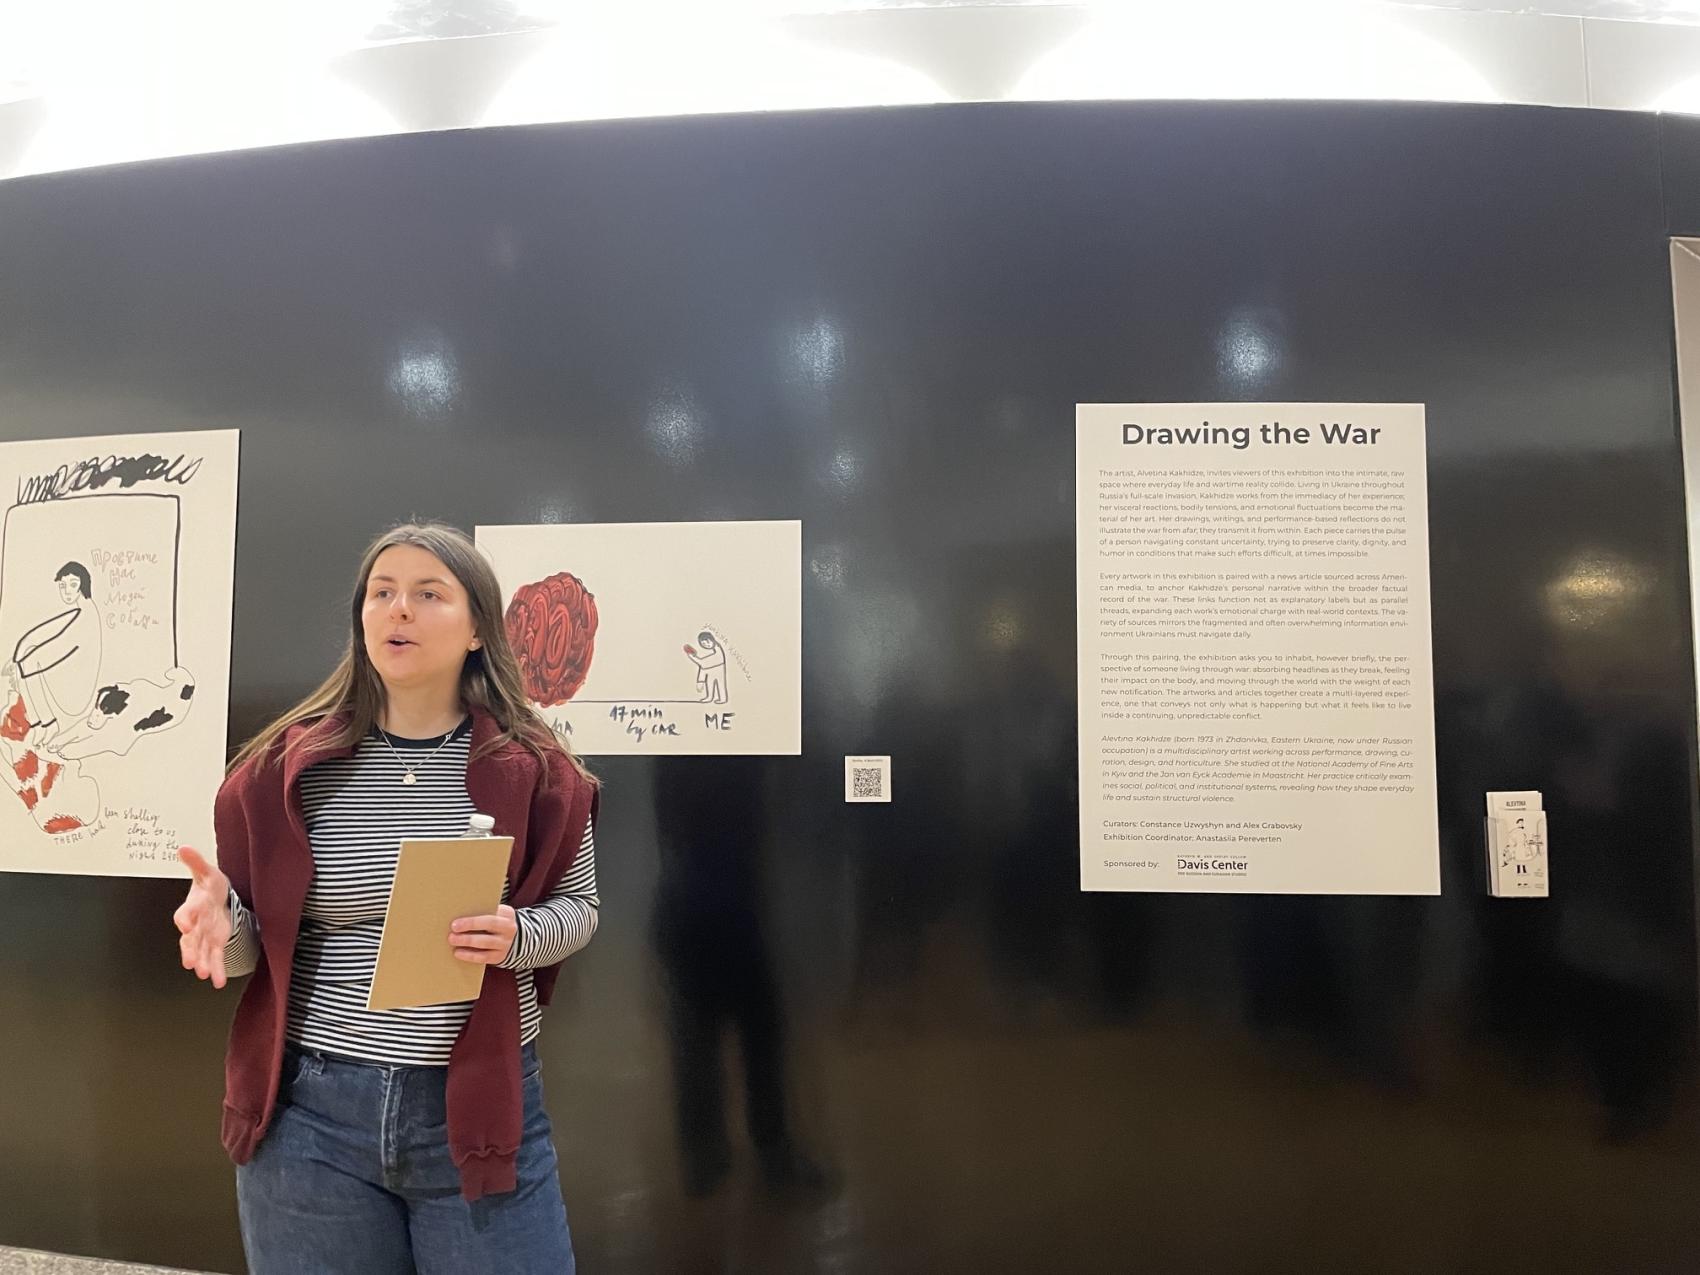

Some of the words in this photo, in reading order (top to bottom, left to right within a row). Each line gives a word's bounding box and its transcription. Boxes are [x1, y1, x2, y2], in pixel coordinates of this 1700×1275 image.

[1122, 421, 1250, 449] Drawing
[1259, 422, 1310, 444] the
[1320, 423, 1381, 444] War
[1206, 468, 1231, 476] invites
[1232, 468, 1261, 476] viewers
[1286, 468, 1323, 476] exhibition
[1099, 481, 1121, 489] space
[1122, 479, 1146, 488] where
[1147, 479, 1181, 489] everyday
[1212, 479, 1243, 488] wartime
[1245, 479, 1268, 490] reality
[1297, 479, 1320, 490] Living
[1330, 479, 1359, 488] Ukraine
[1361, 479, 1404, 490] throughout
[1099, 490, 1128, 499] Russia's
[1130, 490, 1163, 499] full-scale
[1199, 490, 1234, 499] Kakhidze
[1294, 491, 1337, 501] immediacy
[1113, 502, 1141, 510] visceral
[1180, 502, 1203, 512] bodily
[1256, 502, 1295, 511] emotional
[1296, 502, 1341, 511] fluctuations
[1342, 502, 1374, 511] become
[1263, 514, 1337, 524] performance-based
[1339, 514, 1379, 522] reflections
[1217, 525, 1249, 534] transmit
[1115, 538, 1141, 547] person
[1143, 536, 1184, 547] navigating
[1185, 537, 1218, 545] constant
[1267, 537, 1290, 547] trying
[1135, 548, 1175, 556] conditions
[1237, 548, 1262, 557] efforts
[1304, 548, 1326, 557] times
[1099, 571, 1120, 581] Every
[1121, 571, 1151, 580] artwork
[1178, 571, 1216, 580] exhibition
[1225, 571, 1250, 582] paired
[1298, 571, 1322, 580] article
[1323, 571, 1354, 580] sourced
[1158, 582, 1184, 591] anchor
[1188, 582, 1228, 591] Kakhidze's
[1231, 583, 1264, 593] personal
[1267, 583, 1301, 591] narrative
[1304, 583, 1328, 592] within
[1348, 583, 1378, 592] broader
[1381, 583, 1407, 592] factual
[1099, 594, 1124, 602] record
[1172, 594, 1194, 603] These
[1218, 594, 1250, 603] function
[1280, 594, 1325, 605] explanatory
[1131, 605, 1172, 616] expanding
[1193, 606, 1218, 614] work's
[1219, 606, 1258, 615] emotional
[1259, 606, 1286, 617] charge
[1306, 606, 1344, 615] real-world
[1158, 617, 1186, 626] mirrors
[1202, 617, 1247, 628] fragmented
[1343, 618, 1388, 627] information
[1100, 629, 1133, 637] ronment
[1135, 628, 1175, 637] Ukrainians
[1198, 629, 1231, 639] navigate
[1100, 652, 1133, 662] Through
[1198, 652, 1236, 661] exhibition
[1316, 653, 1348, 662] however
[1179, 664, 1200, 674] living
[1202, 664, 1233, 674] through
[1252, 664, 1291, 675] absorbing
[1292, 664, 1329, 673] headlines
[1384, 665, 1409, 675] feeling
[1120, 675, 1148, 685] impact
[1216, 675, 1246, 686] moving
[1248, 675, 1279, 686] through
[1296, 676, 1318, 685] world
[1353, 676, 1380, 687] weight
[1165, 687, 1180, 696] The
[1182, 687, 1216, 696] artworks
[1234, 687, 1262, 696] articles
[1264, 687, 1297, 698] together
[1299, 688, 1323, 697] create
[1332, 688, 1382, 699] multi-layered
[1159, 701, 1192, 709] conveys
[1259, 699, 1302, 710] happening
[609, 705, 628, 722] 17
[630, 704, 663, 719] min
[1102, 709, 1124, 718] inside
[1176, 710, 1231, 721] unpredictable
[705, 712, 735, 730] ME
[626, 720, 647, 743] by
[652, 722, 681, 735] CAR
[1139, 819, 1181, 828] Constance
[1225, 820, 1241, 829] and
[1242, 820, 1259, 829] Alex
[1103, 831, 1143, 841] Exhibition
[1238, 833, 1281, 842] Pereverten
[1103, 858, 1145, 869] Sponsored
[1147, 859, 1159, 870] by:
[1177, 859, 1208, 869] Davis
[1211, 859, 1248, 870] Center
